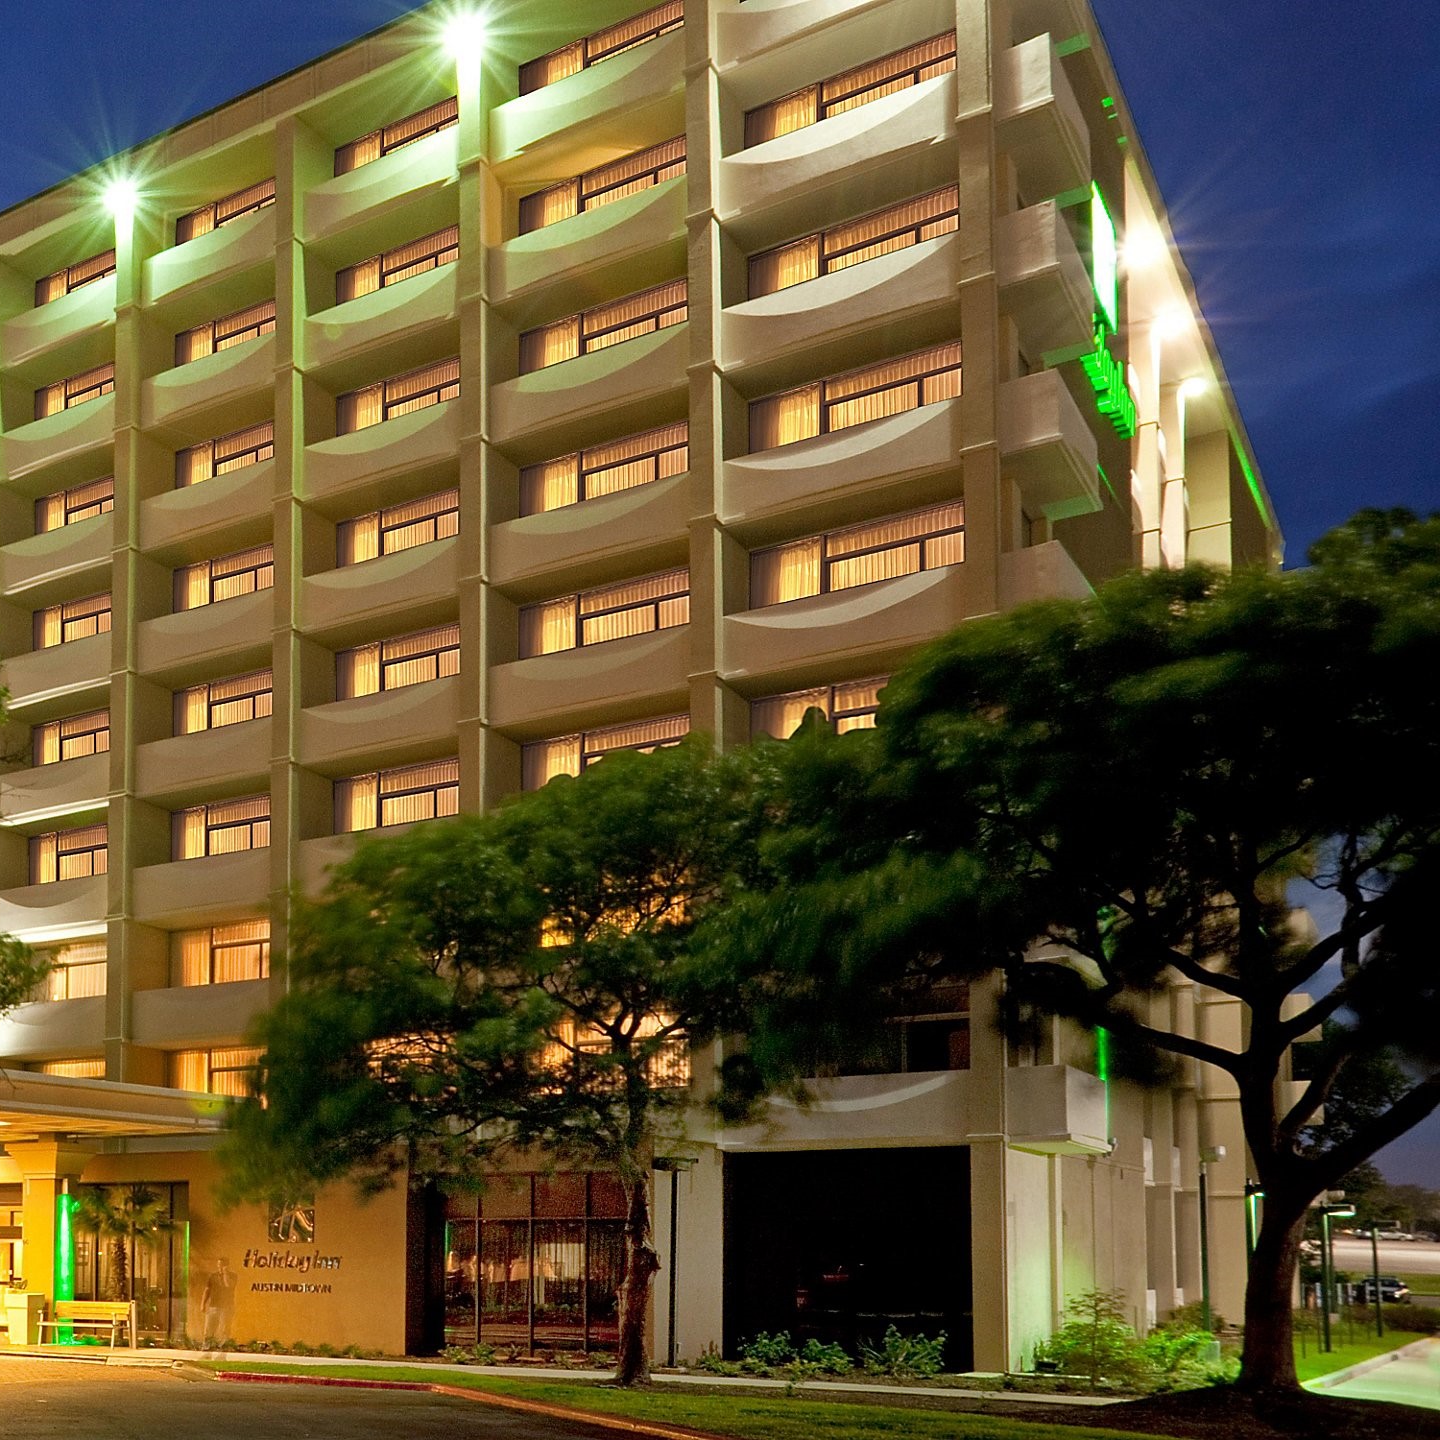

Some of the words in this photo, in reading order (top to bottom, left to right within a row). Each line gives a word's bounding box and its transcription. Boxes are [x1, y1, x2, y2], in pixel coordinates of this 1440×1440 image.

[243, 1249, 311, 1273] Holiday
[313, 1250, 342, 1269] Inn
[251, 1283, 283, 1293] AUSTIN
[285, 1283, 332, 1294] MIDTOWN
